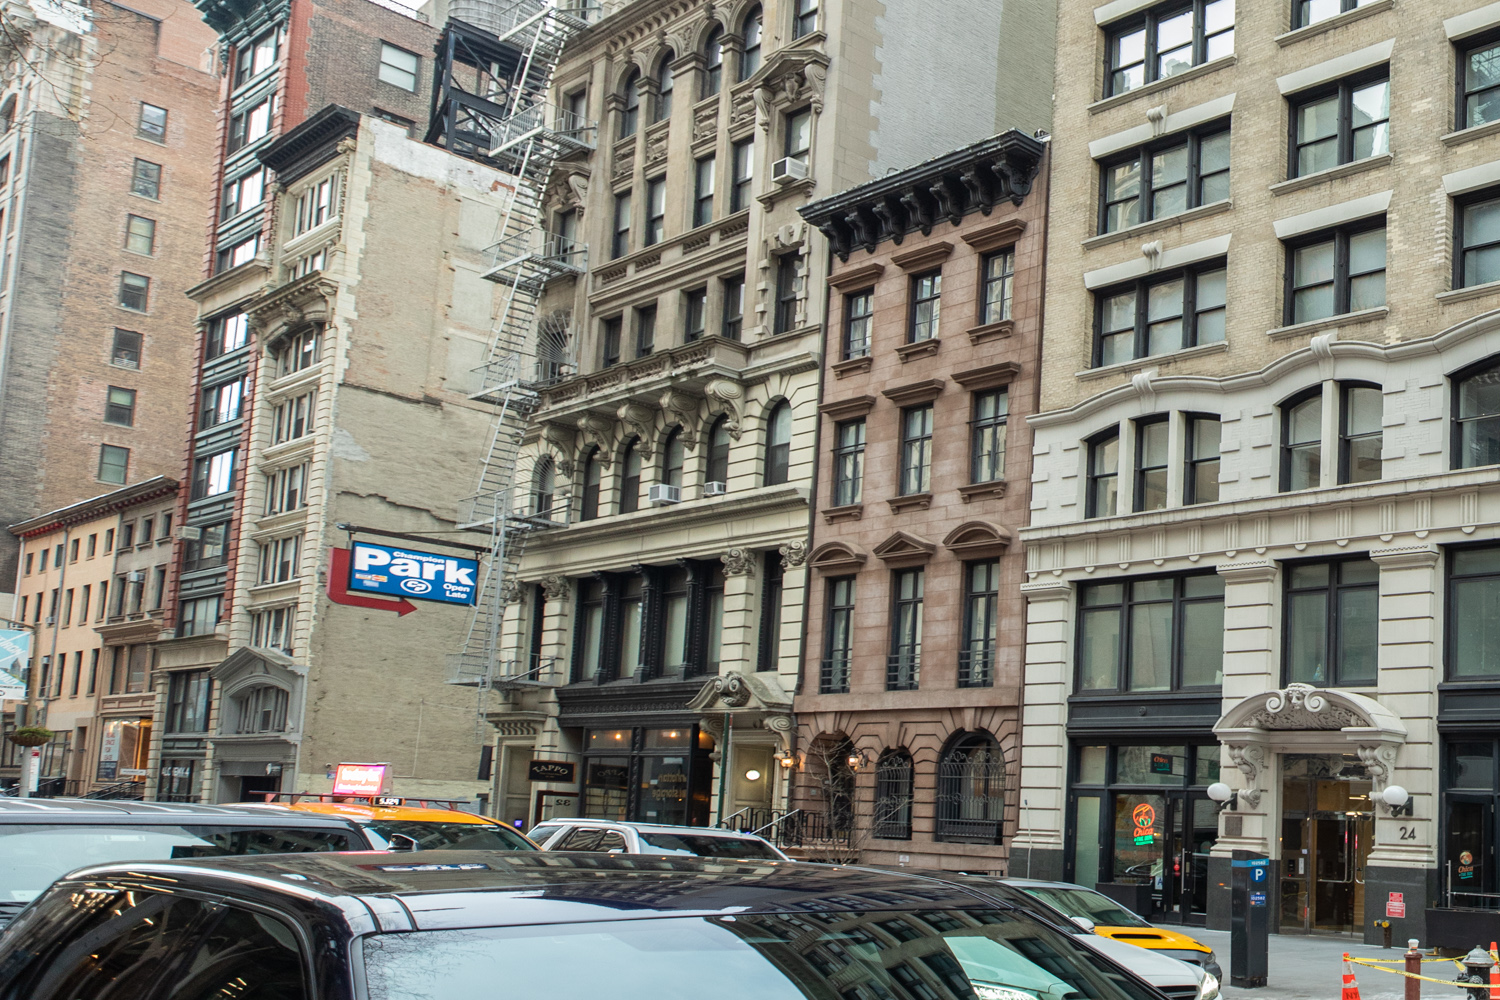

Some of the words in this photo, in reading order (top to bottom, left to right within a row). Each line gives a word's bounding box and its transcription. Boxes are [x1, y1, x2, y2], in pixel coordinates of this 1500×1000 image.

[392, 551, 445, 564] Champion
[354, 546, 475, 586] Park
[442, 583, 470, 593] Open
[445, 590, 467, 599] Late
[532, 764, 568, 775] TAPPO
[1399, 826, 1416, 840] 24
[1255, 869, 1263, 880] P
